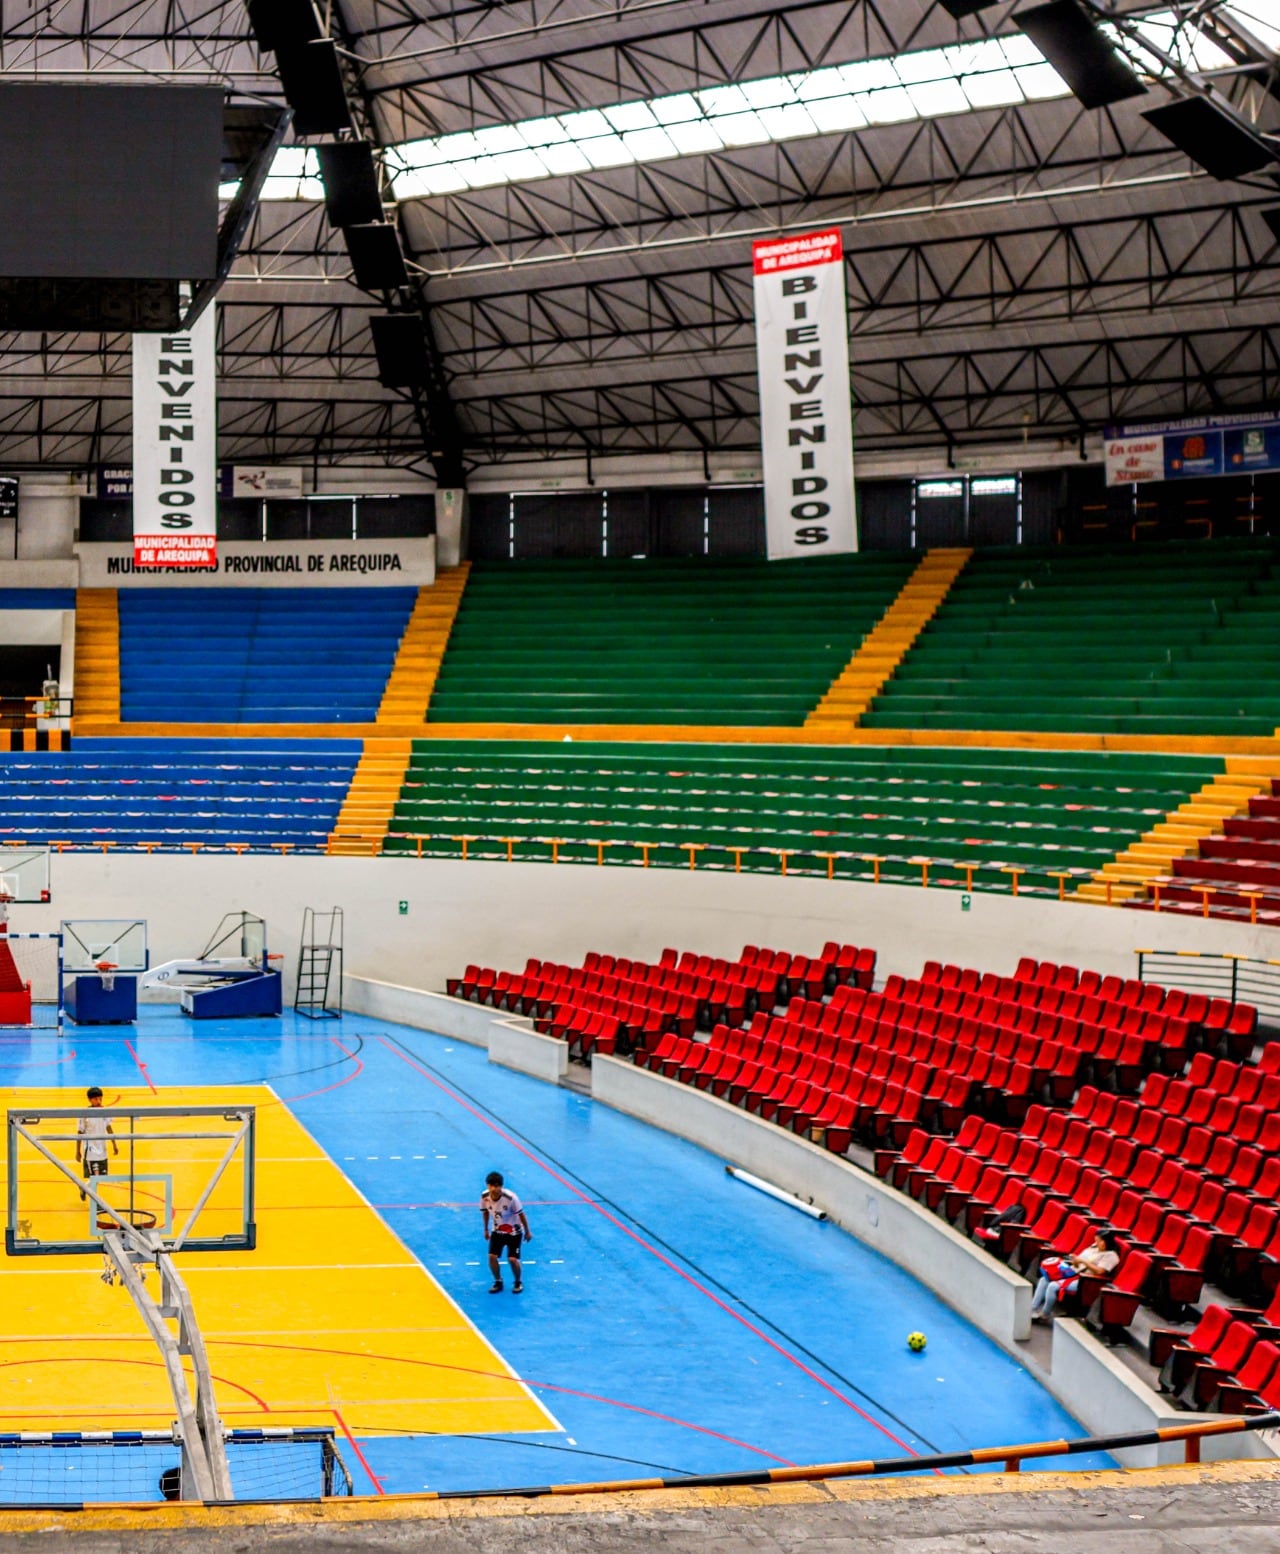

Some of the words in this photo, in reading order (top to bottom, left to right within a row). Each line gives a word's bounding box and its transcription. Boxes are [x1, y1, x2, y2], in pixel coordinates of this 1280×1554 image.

[755, 234, 838, 259] MUNICIPALIDAD
[778, 247, 833, 267] AREQUIPA
[781, 275, 831, 546] BIENVENIDOS
[157, 337, 195, 529] ENVENIDOS
[134, 537, 215, 549] MUNICIPALIDAD
[141, 550, 155, 562] DE
[157, 550, 209, 562] AREQUIPA
[224, 555, 302, 573] PROVINCIAL
[308, 555, 324, 572] DE
[329, 553, 402, 574] AREQUIPA
